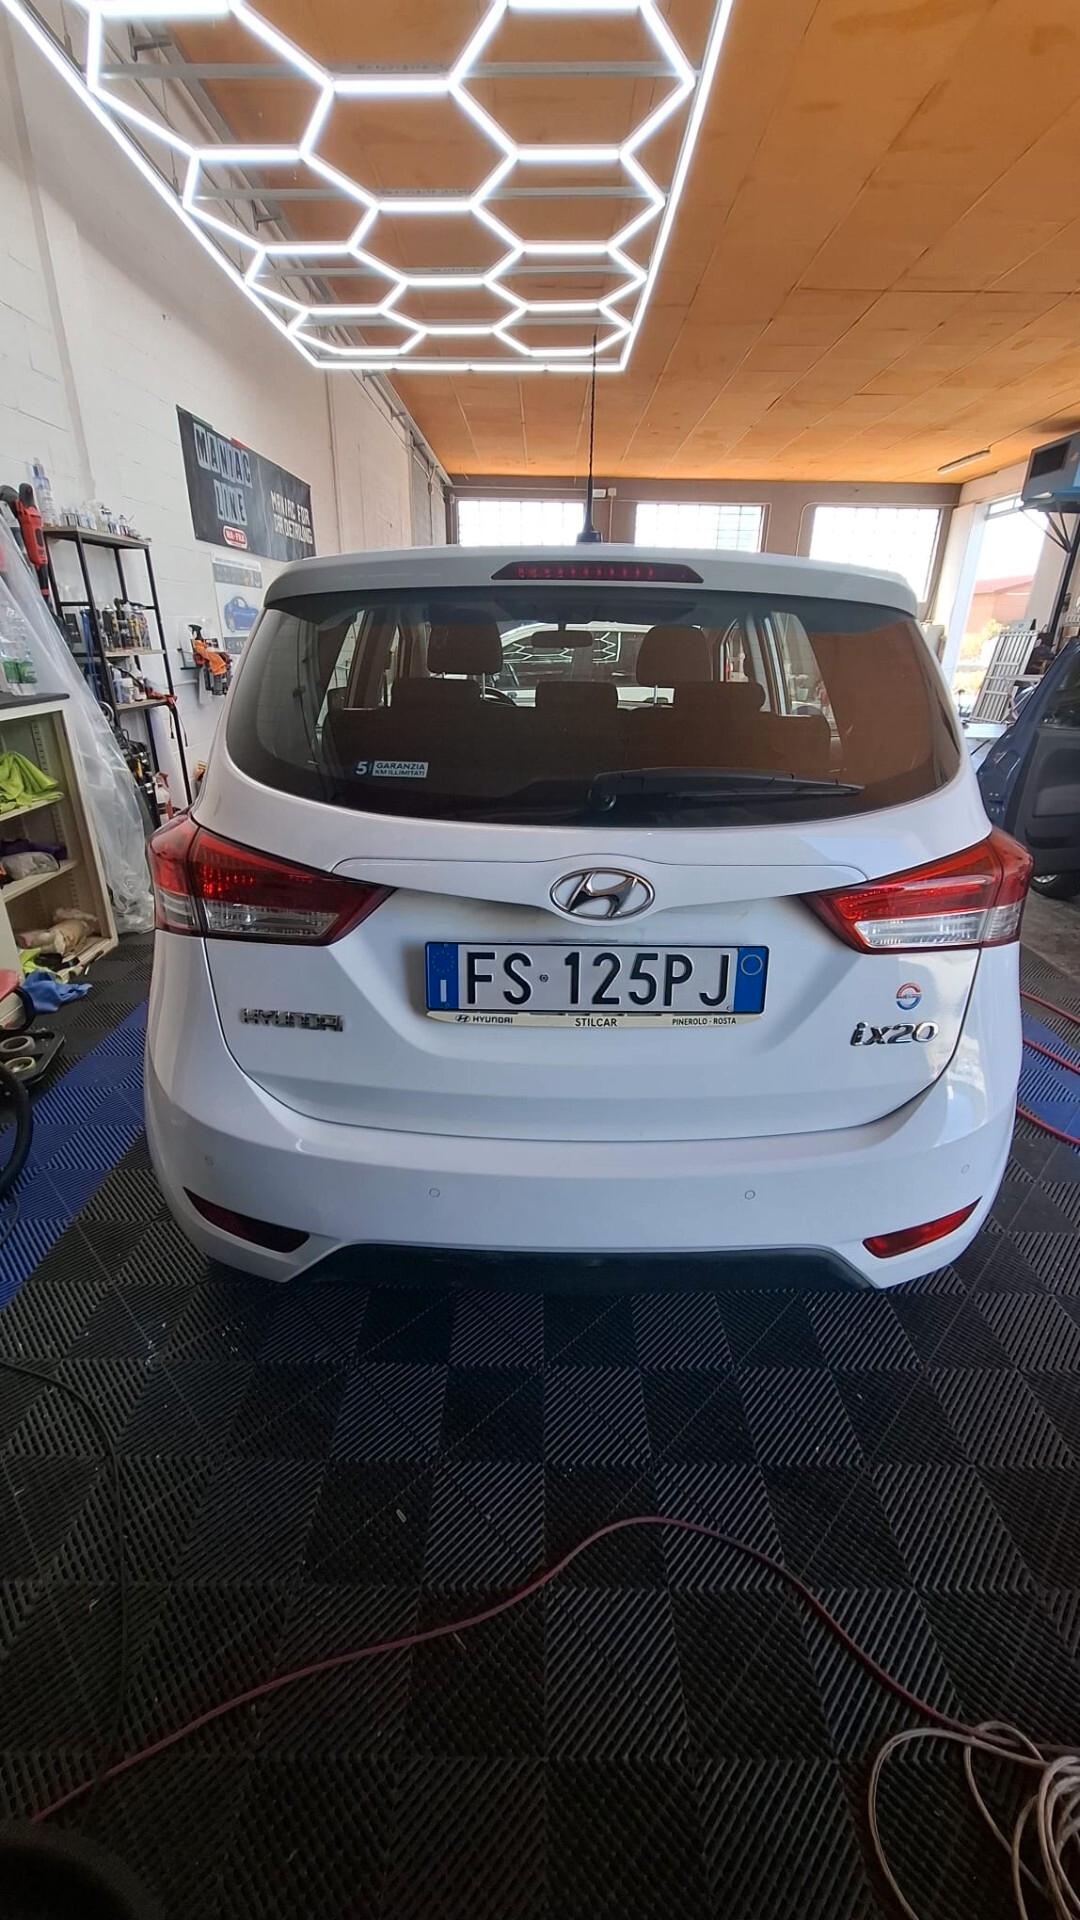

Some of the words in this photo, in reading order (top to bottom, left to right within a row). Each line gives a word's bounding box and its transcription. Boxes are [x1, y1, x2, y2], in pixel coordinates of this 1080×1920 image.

[193, 422, 252, 488] MANIAC
[213, 479, 247, 525] LINE
[297, 503, 311, 526] FOR
[356, 761, 368, 775] 5
[376, 762, 425, 770] GARANZIA
[466, 952, 532, 1005] FS
[564, 953, 729, 1006] 125PJ
[472, 1016, 513, 1024] HYUNDAI
[575, 1017, 618, 1027] STILCAR
[672, 1017, 708, 1025] PINEROLO
[713, 1017, 736, 1025] ROSTA
[850, 1021, 939, 1046] ix20
